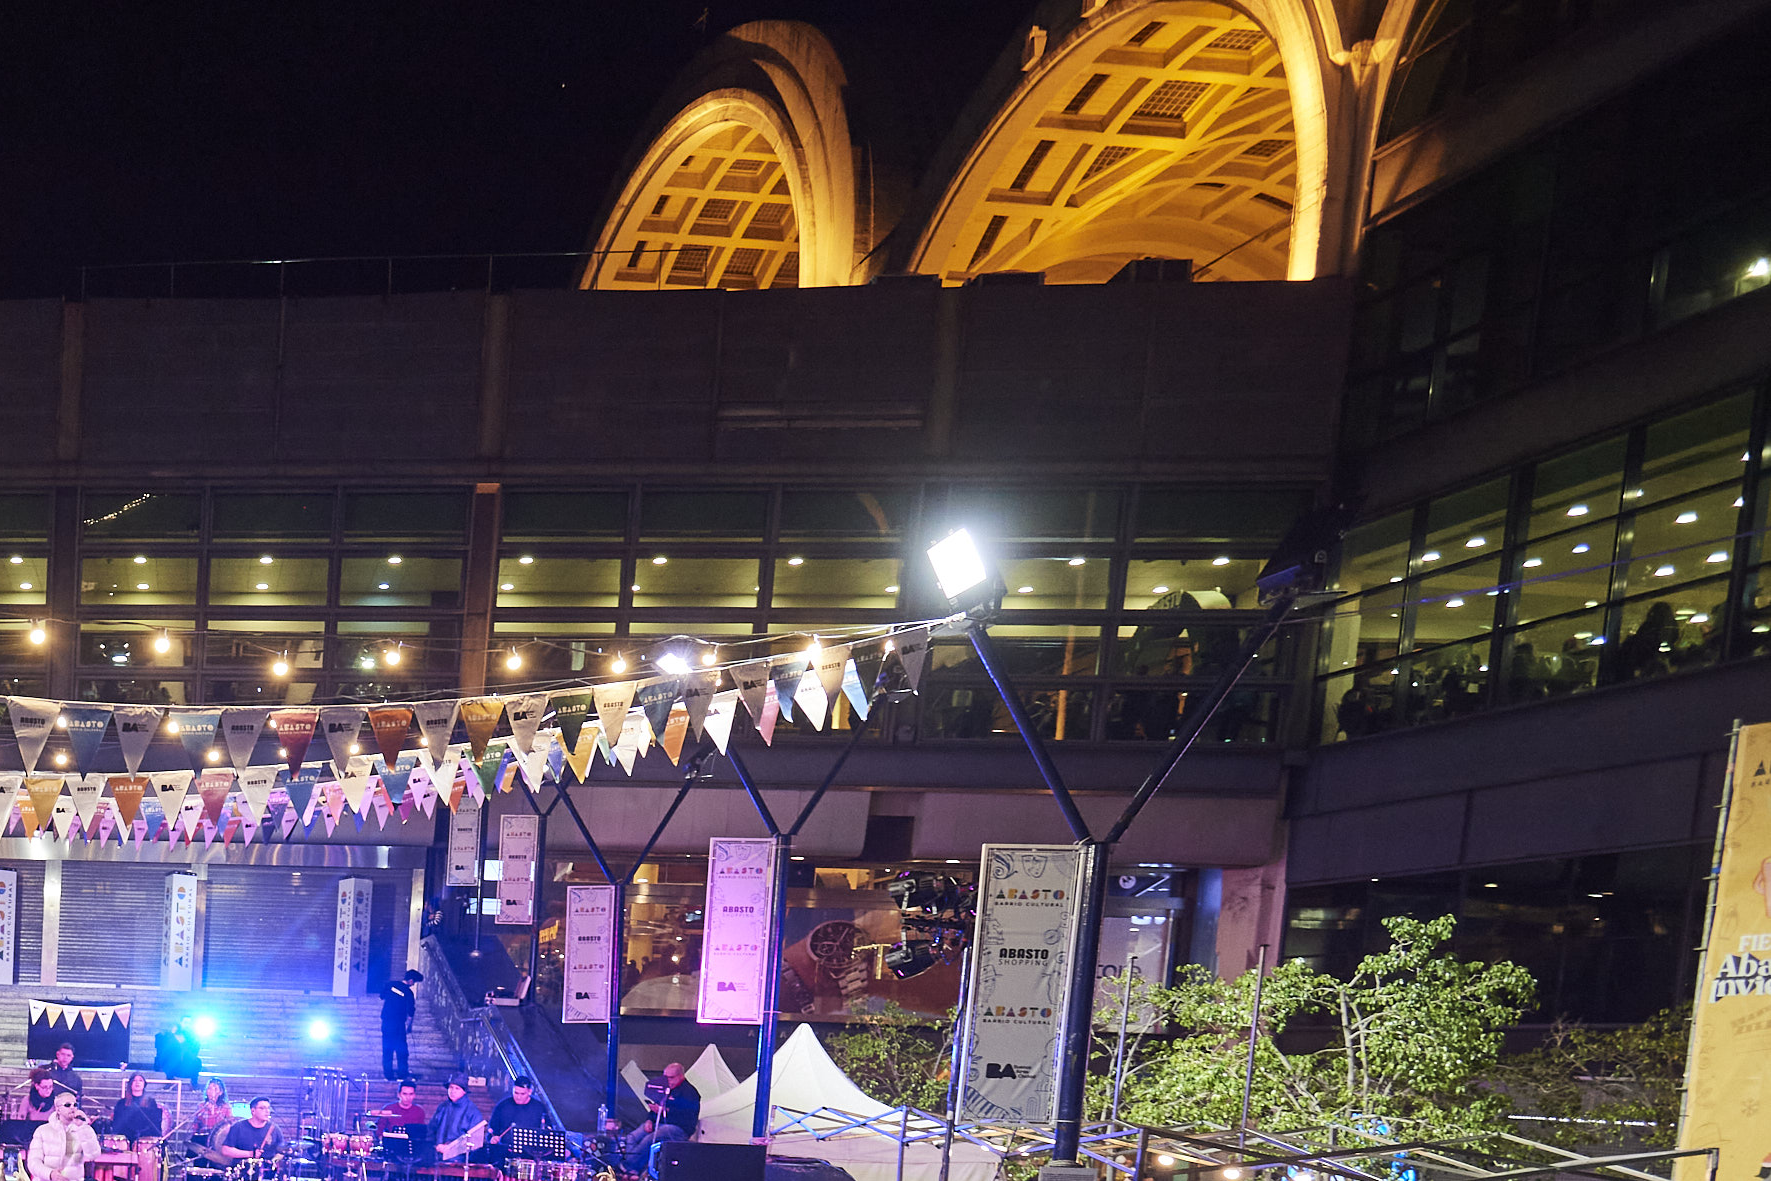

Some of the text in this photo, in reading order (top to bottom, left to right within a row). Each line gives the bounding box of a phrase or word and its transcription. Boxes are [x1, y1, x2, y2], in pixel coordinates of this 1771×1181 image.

[558, 704, 587, 714] ABASTO
[69, 720, 104, 729] ABASTO
[180, 724, 214, 732] ABASTO
[279, 724, 312, 732] ABASTO
[201, 780, 229, 788] ABASTO
[996, 889, 1065, 900] ABASTO
[174, 886, 186, 967] ABASTO
[337, 891, 347, 971] ABASTO
[999, 948, 1049, 959] ABASTO
[998, 959, 1049, 967] SHOPPING
[717, 981, 736, 992] BA
[983, 1006, 1052, 1018] ABASTO
[986, 1063, 1017, 1079] BA
